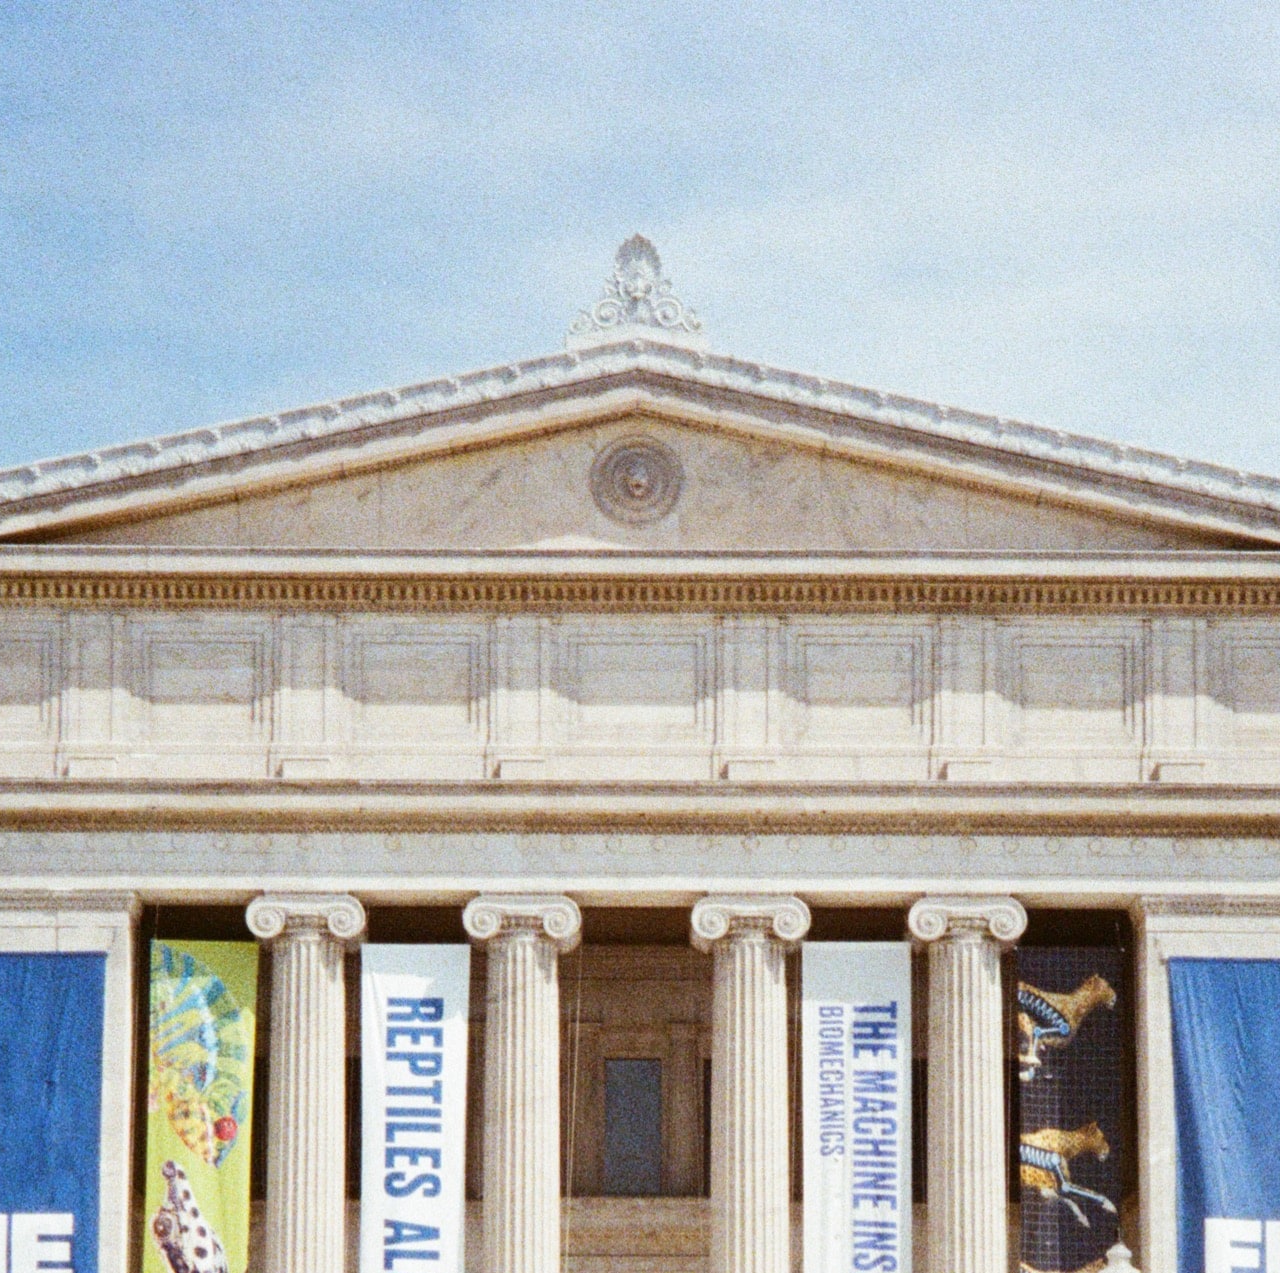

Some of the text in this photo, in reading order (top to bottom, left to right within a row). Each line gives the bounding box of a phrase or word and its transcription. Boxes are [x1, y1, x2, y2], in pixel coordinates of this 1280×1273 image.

[384, 996, 445, 1198] REPTILES
[818, 1005, 845, 1157] BIOMECHANICS
[851, 1000, 899, 1059] THE
[851, 1069, 898, 1210] MACHINE
